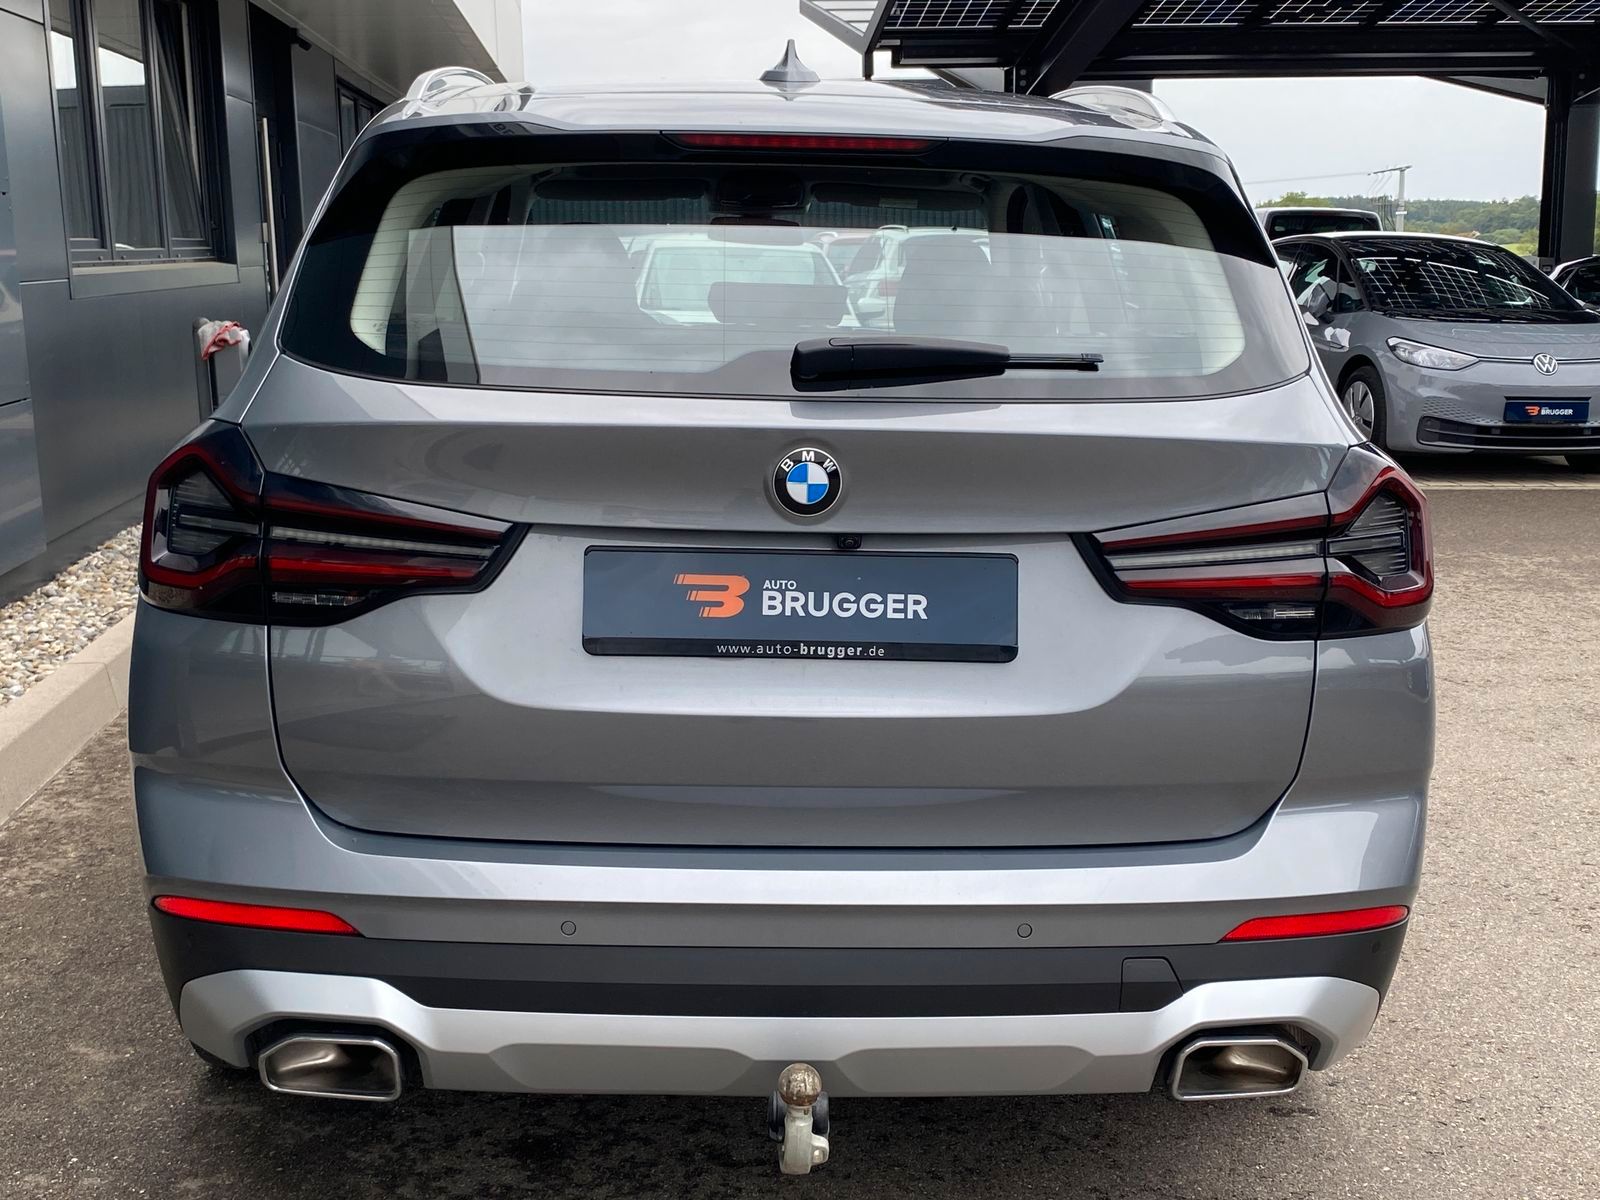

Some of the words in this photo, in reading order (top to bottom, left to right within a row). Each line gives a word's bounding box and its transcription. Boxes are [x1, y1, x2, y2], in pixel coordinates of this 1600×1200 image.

[780, 450, 837, 473] BMW
[763, 579, 797, 590] AUTO
[761, 590, 928, 620] BRUGGER
[716, 642, 885, 658] www.auto-brugger.de
